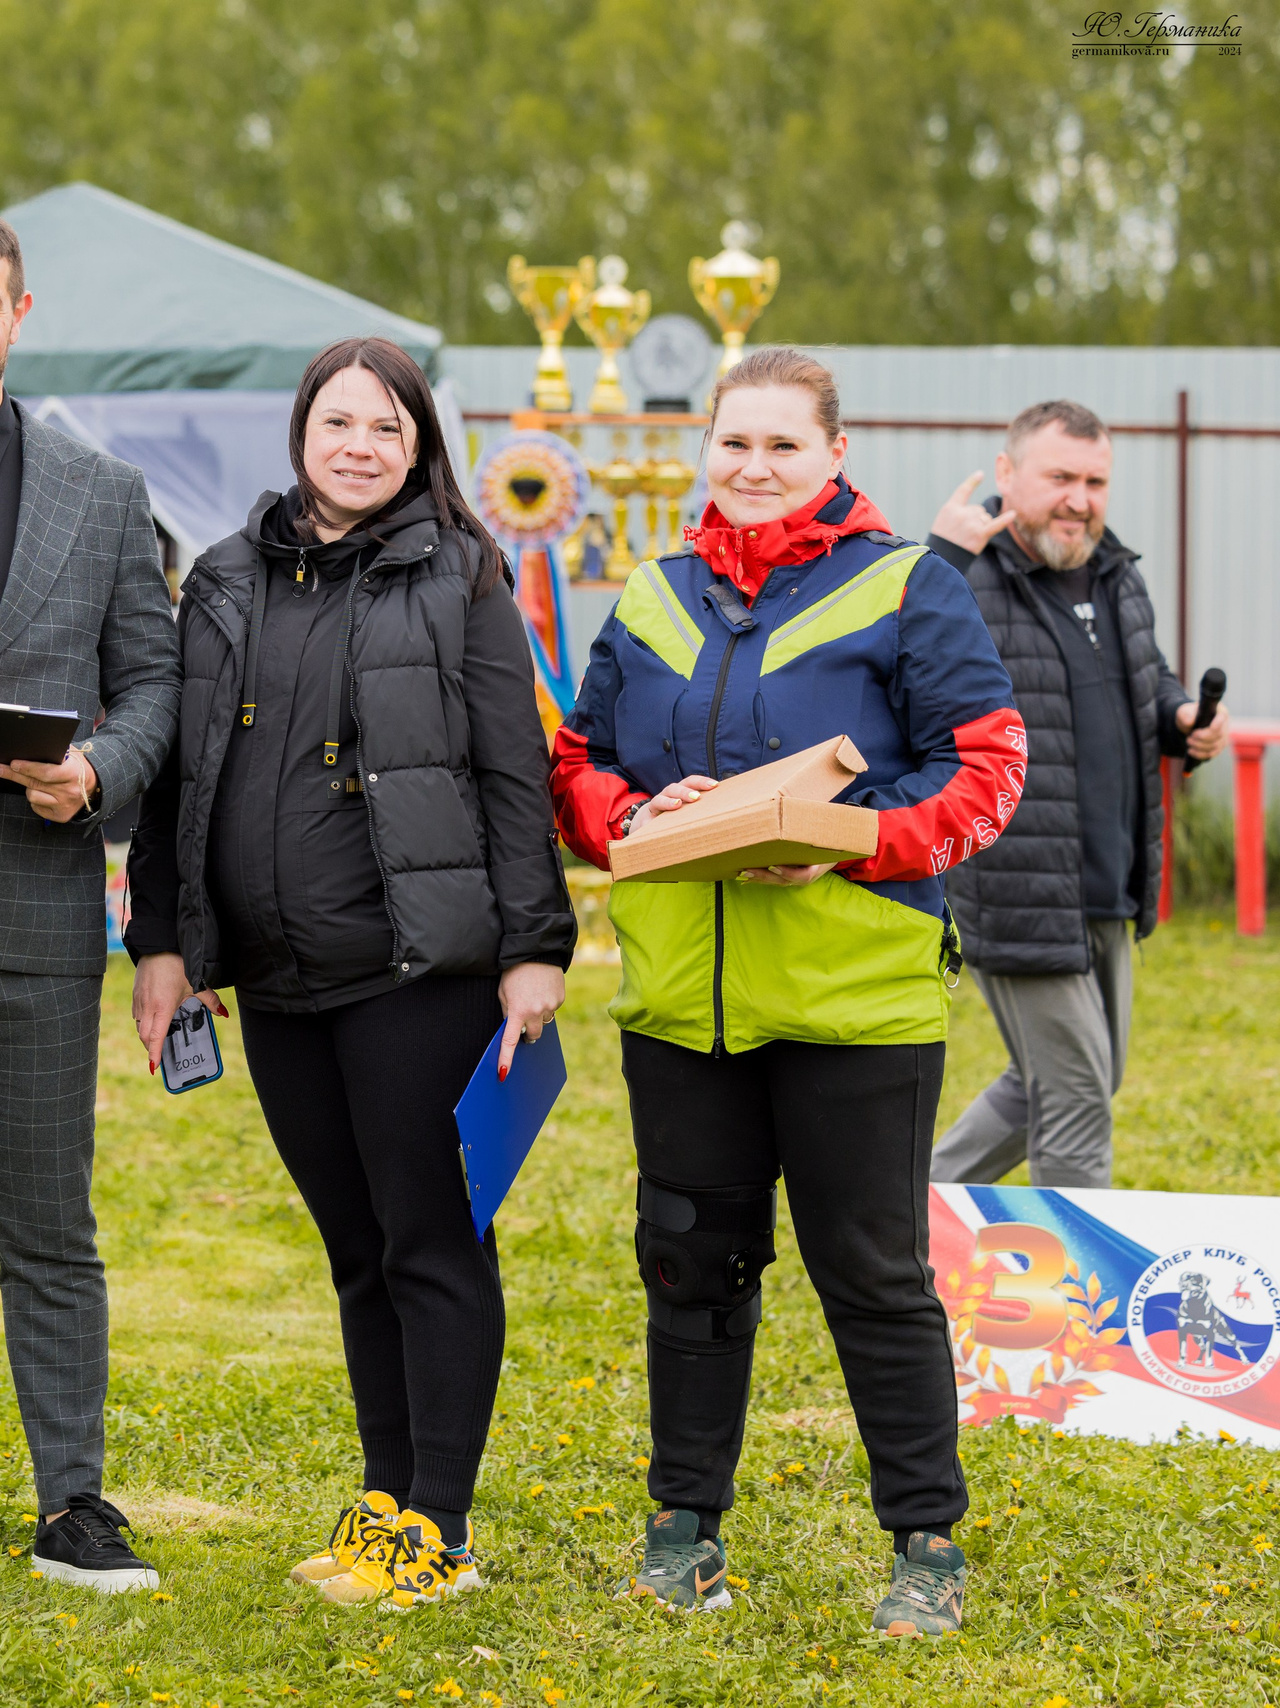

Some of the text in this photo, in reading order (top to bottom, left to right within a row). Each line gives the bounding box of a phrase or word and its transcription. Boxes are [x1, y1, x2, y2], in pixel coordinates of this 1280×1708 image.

[175, 1053, 206, 1072] 10:02
[971, 1221, 1069, 1351] 3
[1132, 1249, 1193, 1327] РОТВЕЙЛЕР
[1204, 1247, 1249, 1267] КЛУБ
[1140, 1351, 1276, 1396] НИЖЕГОРОДСКОЕ РО
